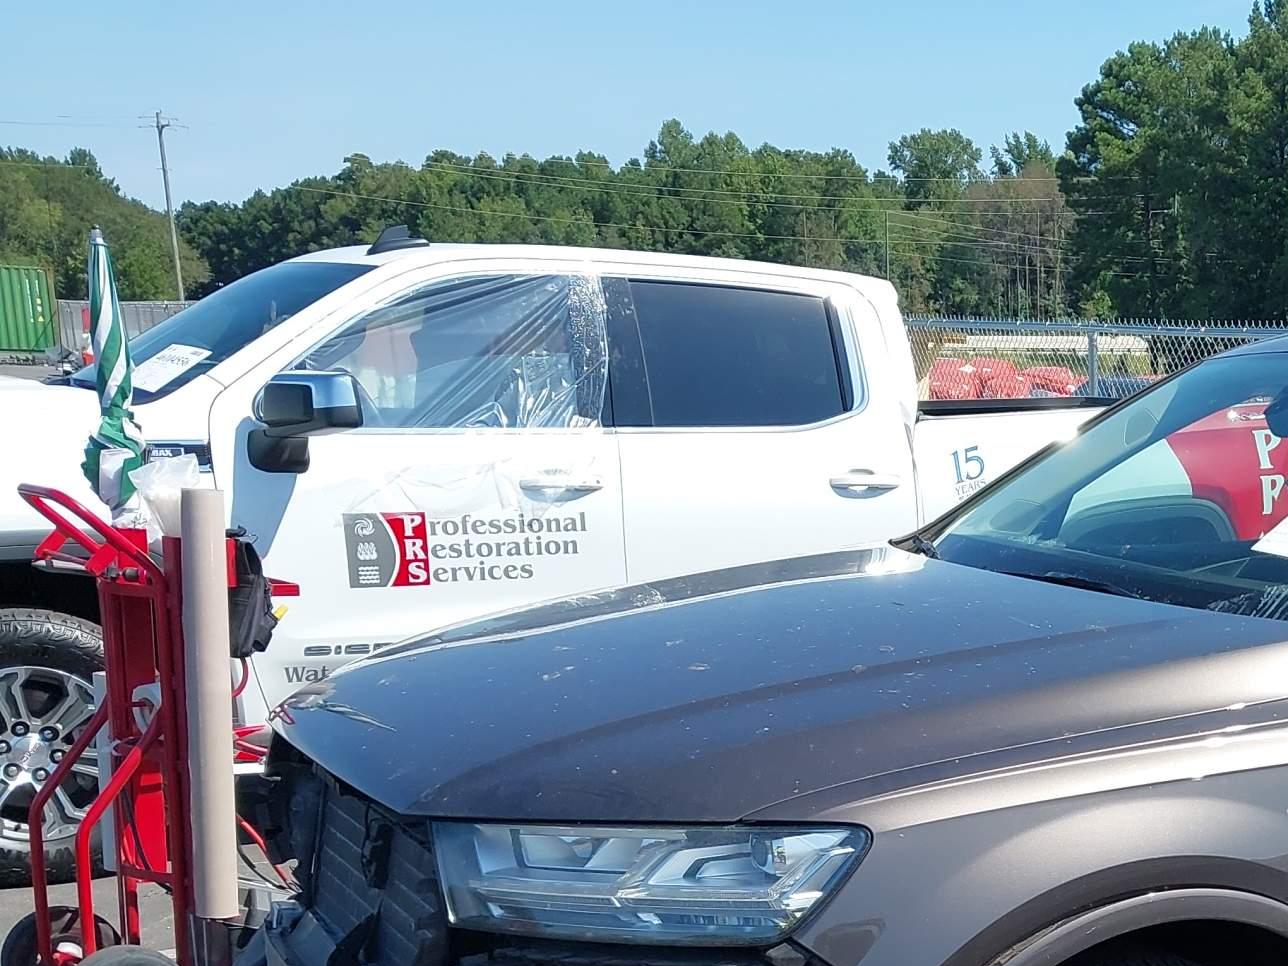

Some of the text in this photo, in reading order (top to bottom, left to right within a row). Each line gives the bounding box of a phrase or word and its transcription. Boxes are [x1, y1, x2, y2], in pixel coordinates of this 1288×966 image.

[951, 445, 985, 484] 15
[402, 511, 588, 537] Professional
[404, 535, 580, 560] Restoration
[408, 560, 534, 583] Services
